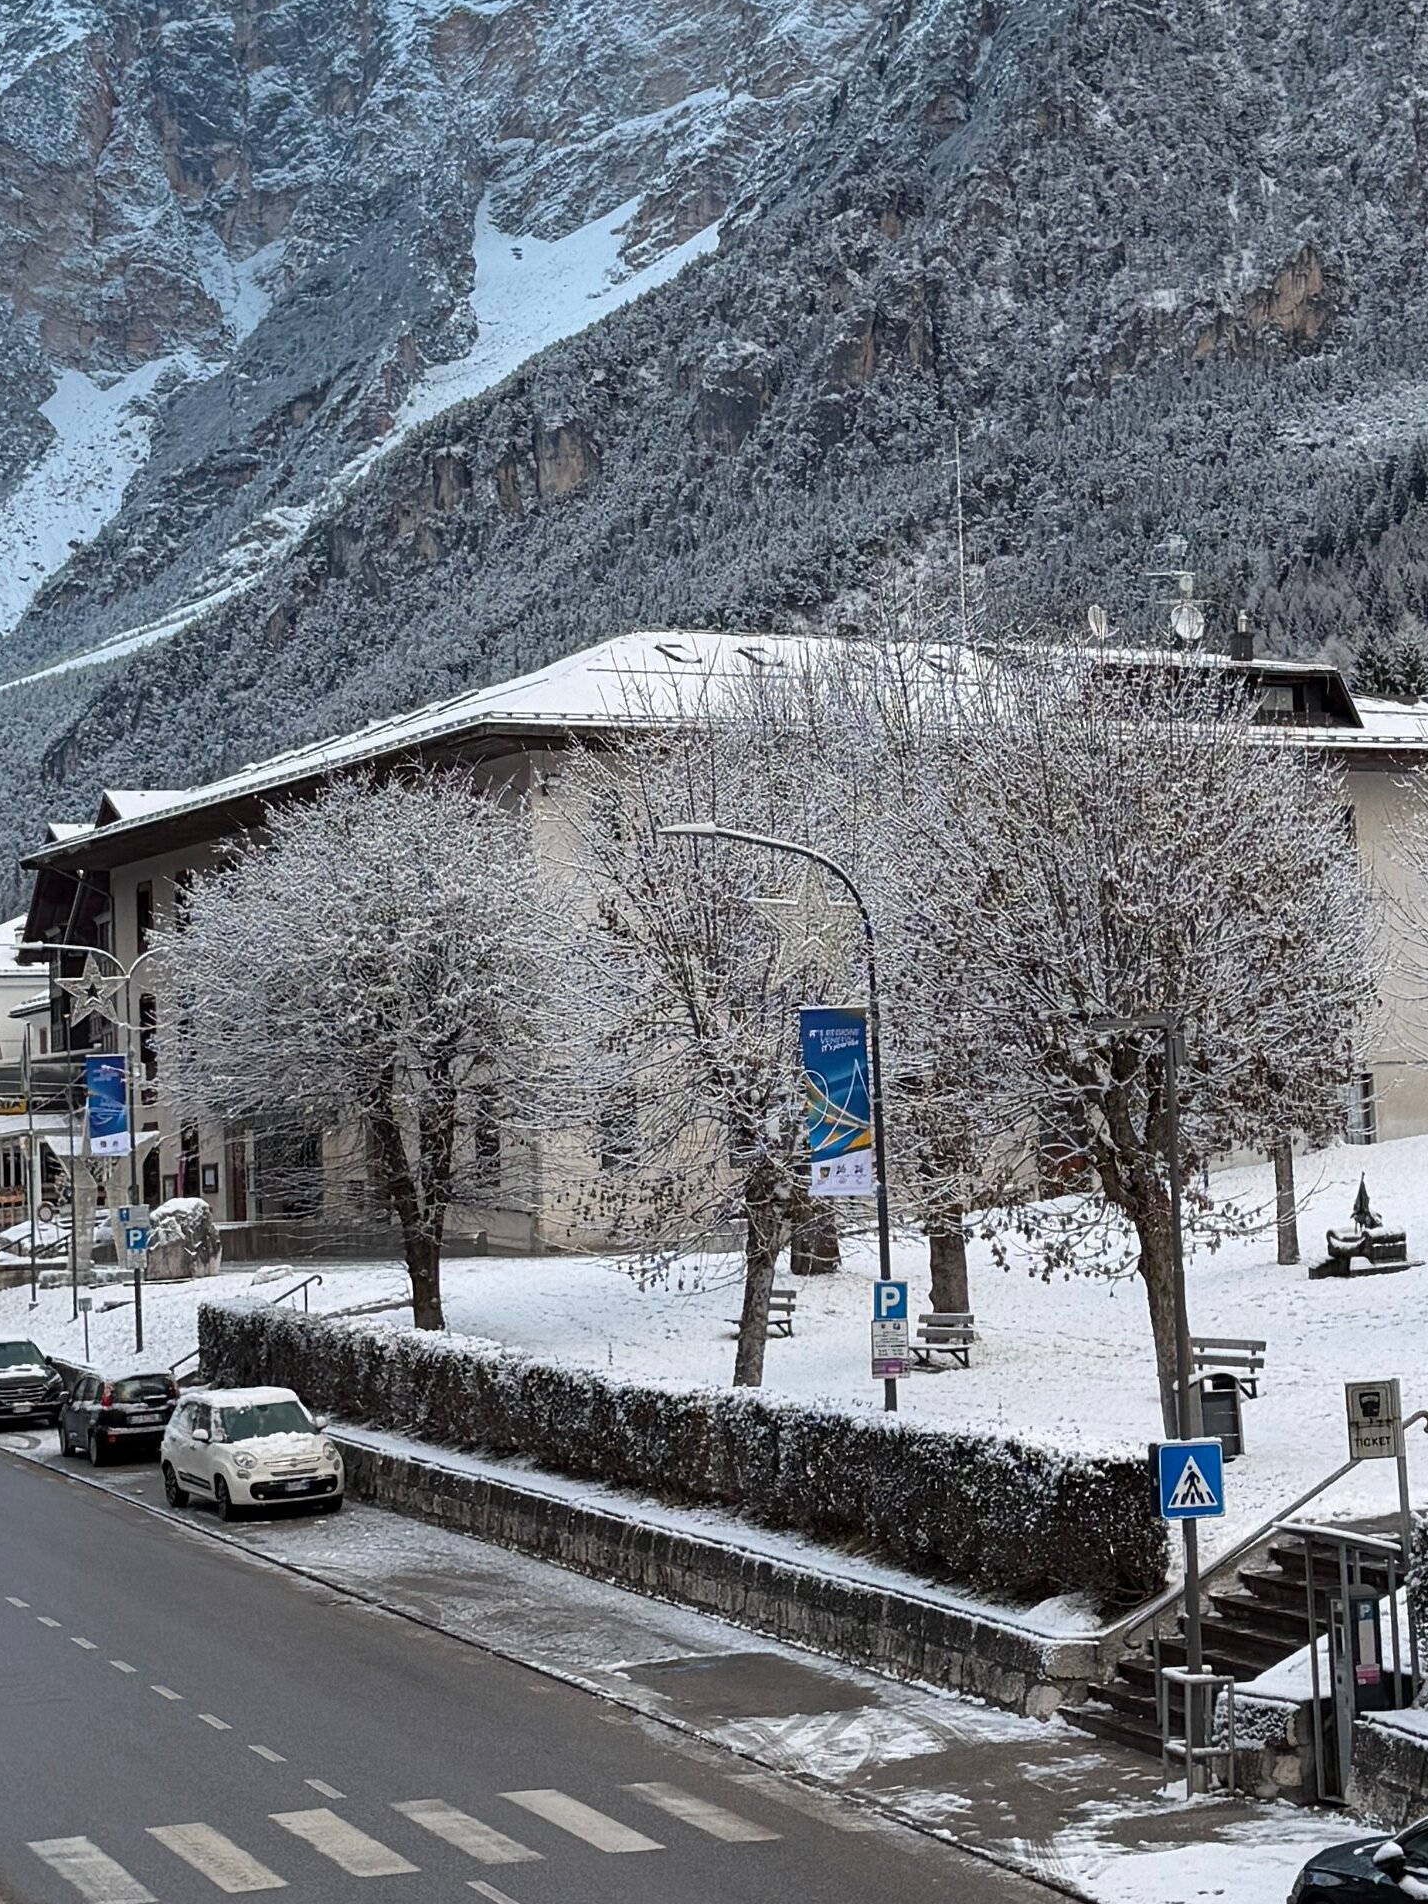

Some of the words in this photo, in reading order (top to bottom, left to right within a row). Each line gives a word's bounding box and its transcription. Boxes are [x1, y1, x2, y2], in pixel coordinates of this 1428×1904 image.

[129, 1229, 142, 1247] P
[880, 1286, 901, 1317] P
[1354, 1436, 1391, 1448] TICKET
[1359, 1604, 1371, 1619] P
